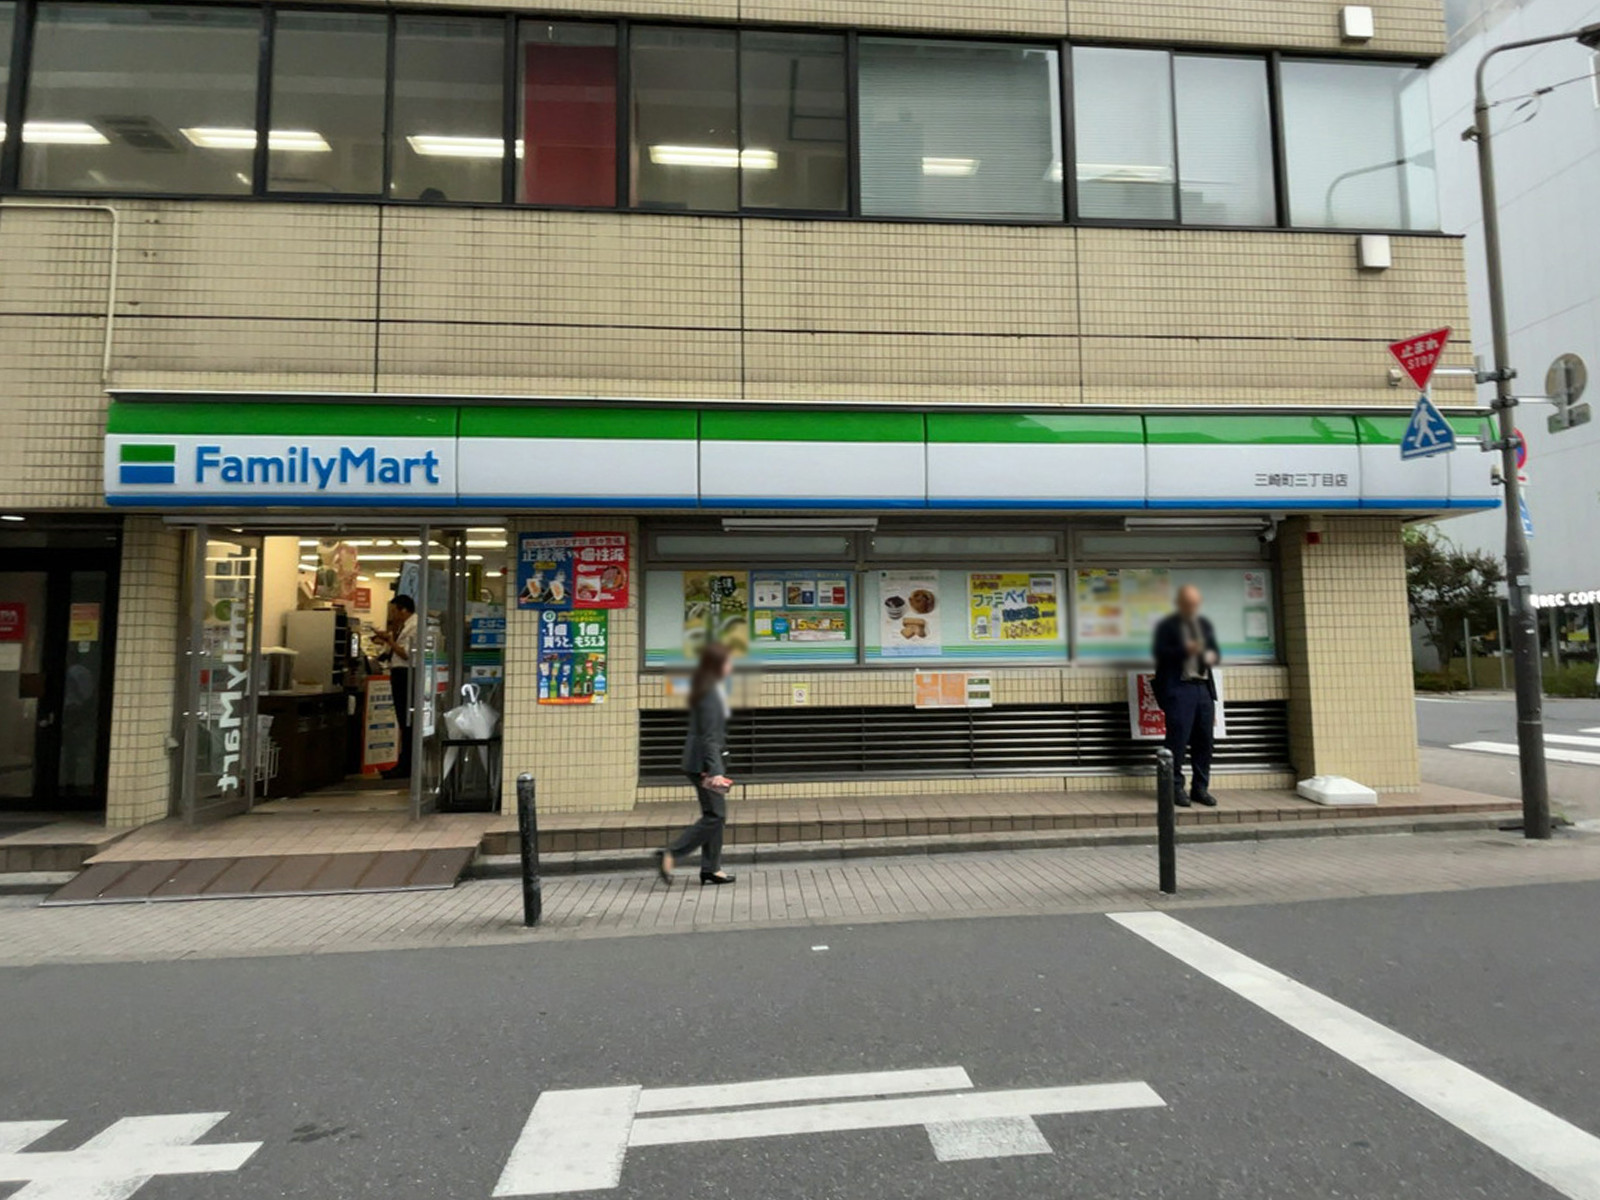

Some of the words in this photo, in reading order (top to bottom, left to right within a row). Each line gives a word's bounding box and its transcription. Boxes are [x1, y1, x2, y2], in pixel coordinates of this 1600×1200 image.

[1400, 338, 1439, 359] 止まれ
[1406, 354, 1435, 370] STOP
[196, 446, 439, 490] FamilyMart
[1254, 473, 1349, 487] 三崎町三丁目店
[580, 547, 625, 562] 個性派
[972, 588, 1027, 608] ファミペイ
